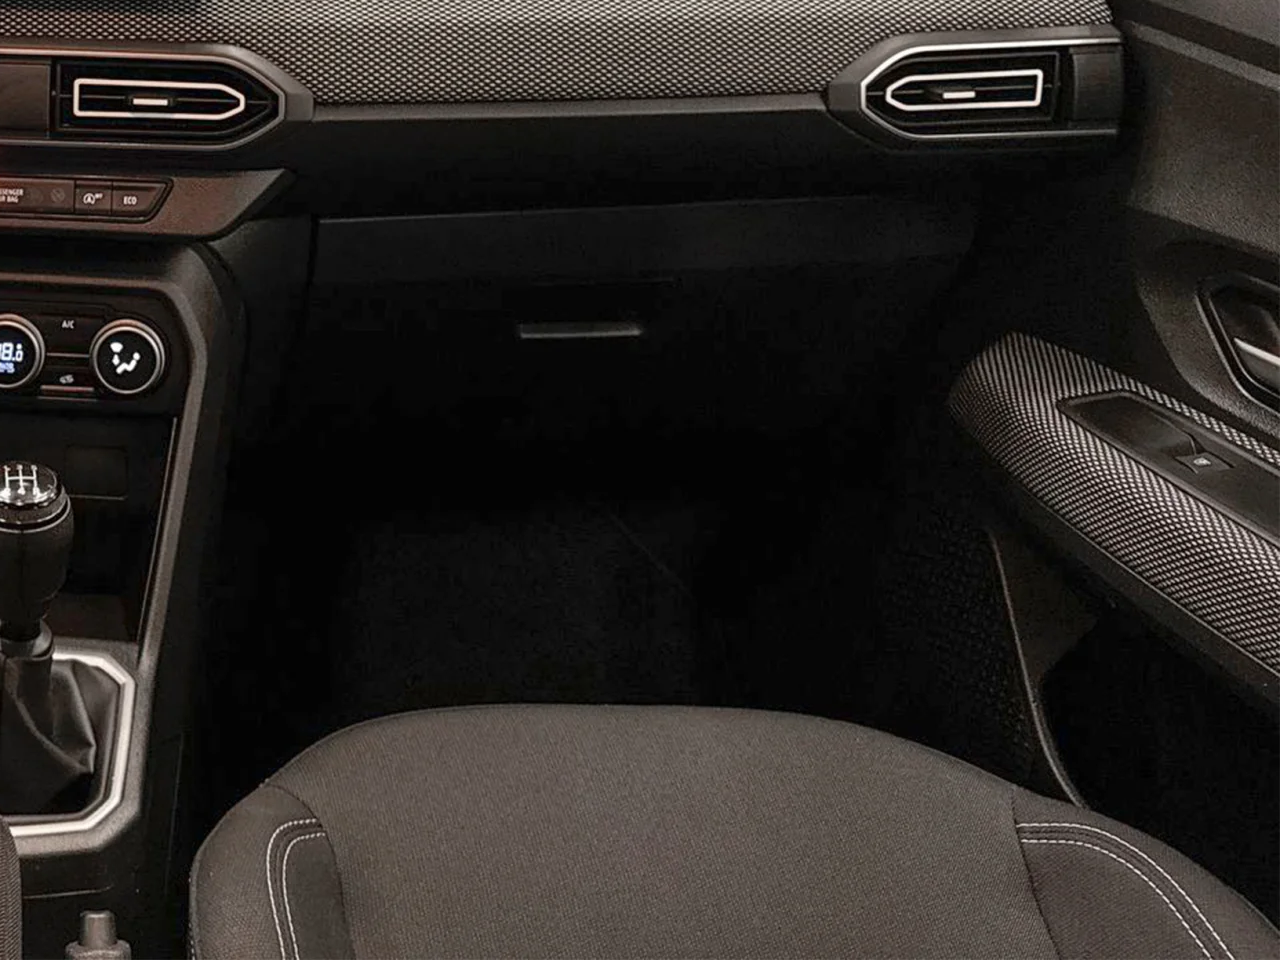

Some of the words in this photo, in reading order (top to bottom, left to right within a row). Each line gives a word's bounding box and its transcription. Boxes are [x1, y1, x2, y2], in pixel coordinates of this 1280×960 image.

[6, 195, 19, 203] BAG
[123, 196, 138, 206] ECO
[61, 320, 75, 329] A/C
